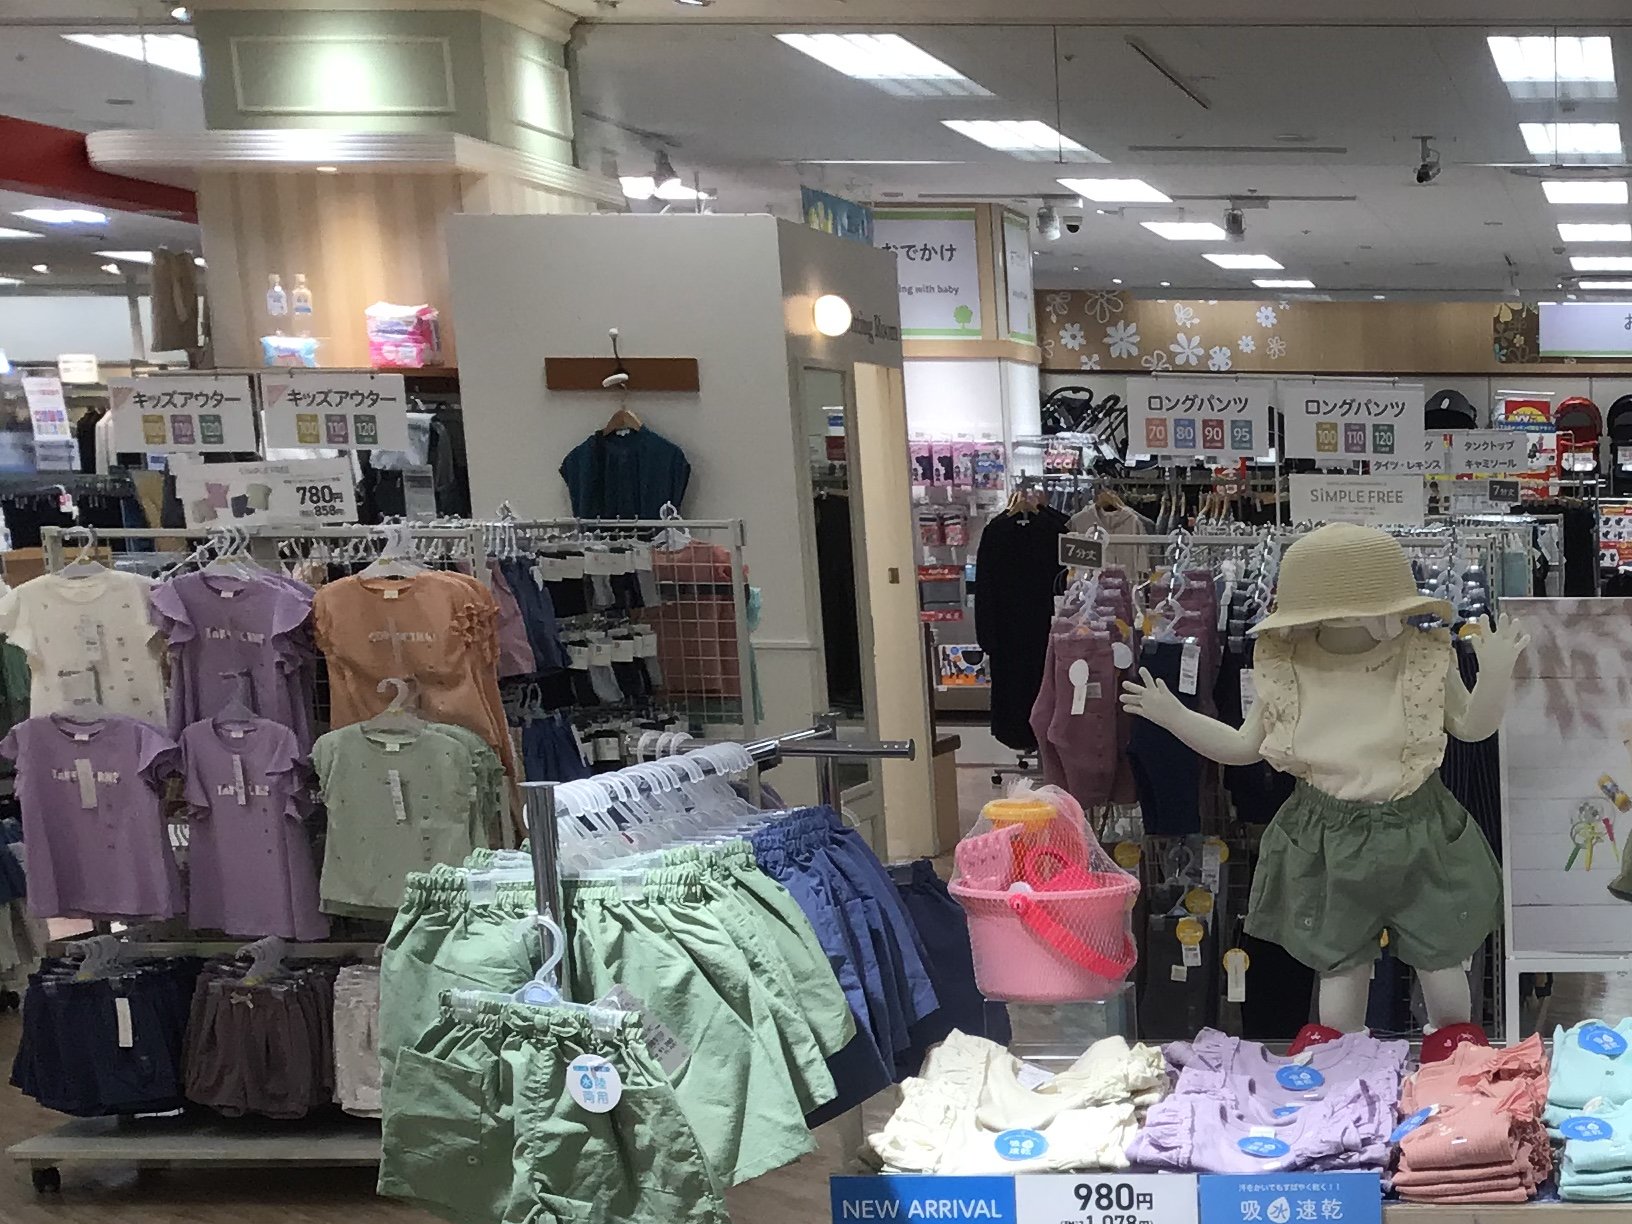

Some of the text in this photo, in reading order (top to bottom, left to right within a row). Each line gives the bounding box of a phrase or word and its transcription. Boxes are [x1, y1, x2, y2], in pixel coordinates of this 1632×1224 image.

[915, 284, 935, 294] with
[937, 284, 960, 296] baby
[132, 390, 242, 409] キッズアウター
[287, 389, 397, 408] キッズアウター
[1147, 395, 1249, 413] ロングパンツ
[1304, 400, 1406, 418] ロングパンツ
[201, 422, 222, 436] 120
[357, 421, 376, 435] 120
[1148, 425, 1251, 442] 70 80 90 95
[1317, 431, 1393, 446] 100 110 120
[1464, 440, 1515, 451] タンクトップ
[1465, 458, 1517, 469] キャミソール
[1367, 489, 1404, 505] FREE
[1073, 1183, 1153, 1211] 980円
[843, 1200, 1002, 1219] NEW ARRIVAL
[1240, 1197, 1343, 1224] 吸水速乾
